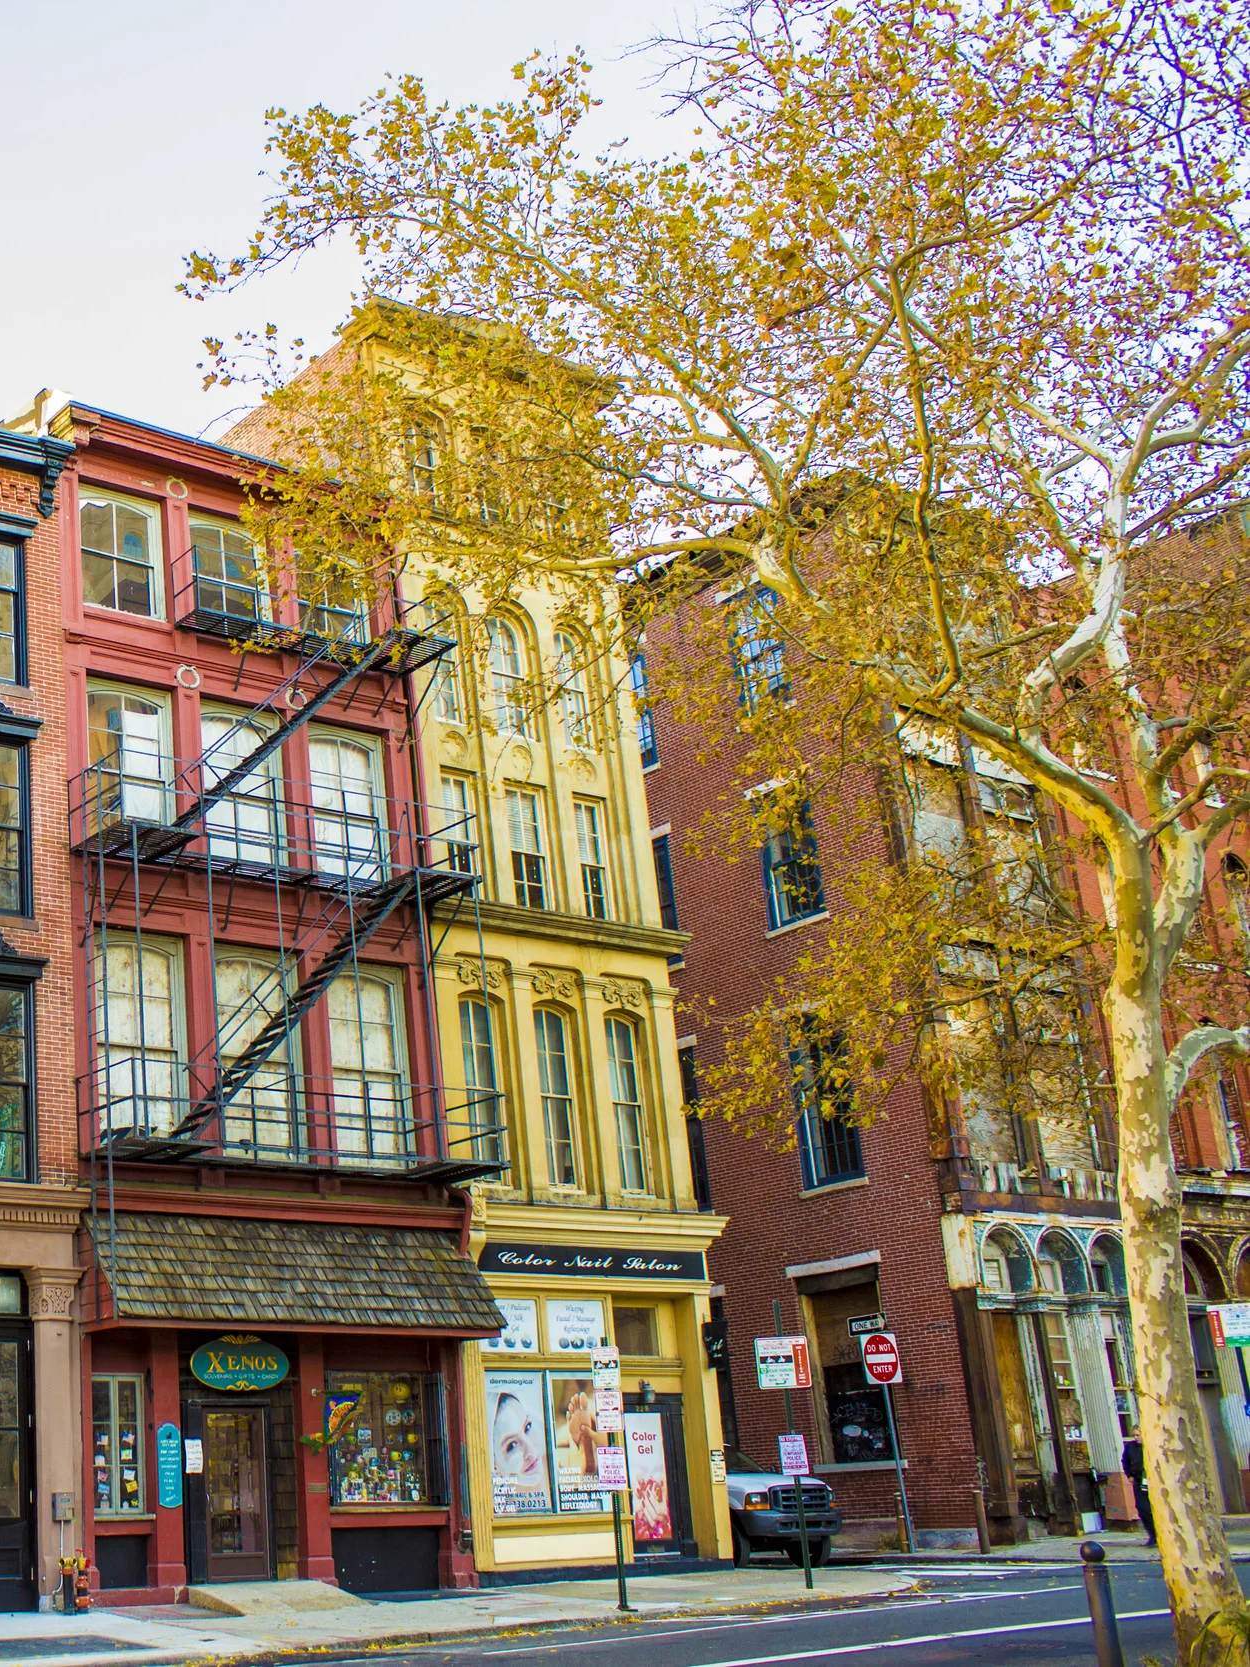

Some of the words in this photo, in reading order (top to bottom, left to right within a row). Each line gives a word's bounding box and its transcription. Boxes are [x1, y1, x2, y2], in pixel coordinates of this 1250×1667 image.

[498, 1251, 557, 1265] Color
[564, 1255, 613, 1268] Nail
[622, 1257, 682, 1271] Salon
[854, 1321, 869, 1331] ONE
[867, 1344, 876, 1352] DO
[878, 1343, 891, 1352] NOT
[206, 1352, 278, 1373] XENOS
[873, 1365, 893, 1374] ENTER
[490, 1378, 533, 1386] dermalogica
[632, 1432, 656, 1441] Color
[637, 1445, 654, 1455] Gel
